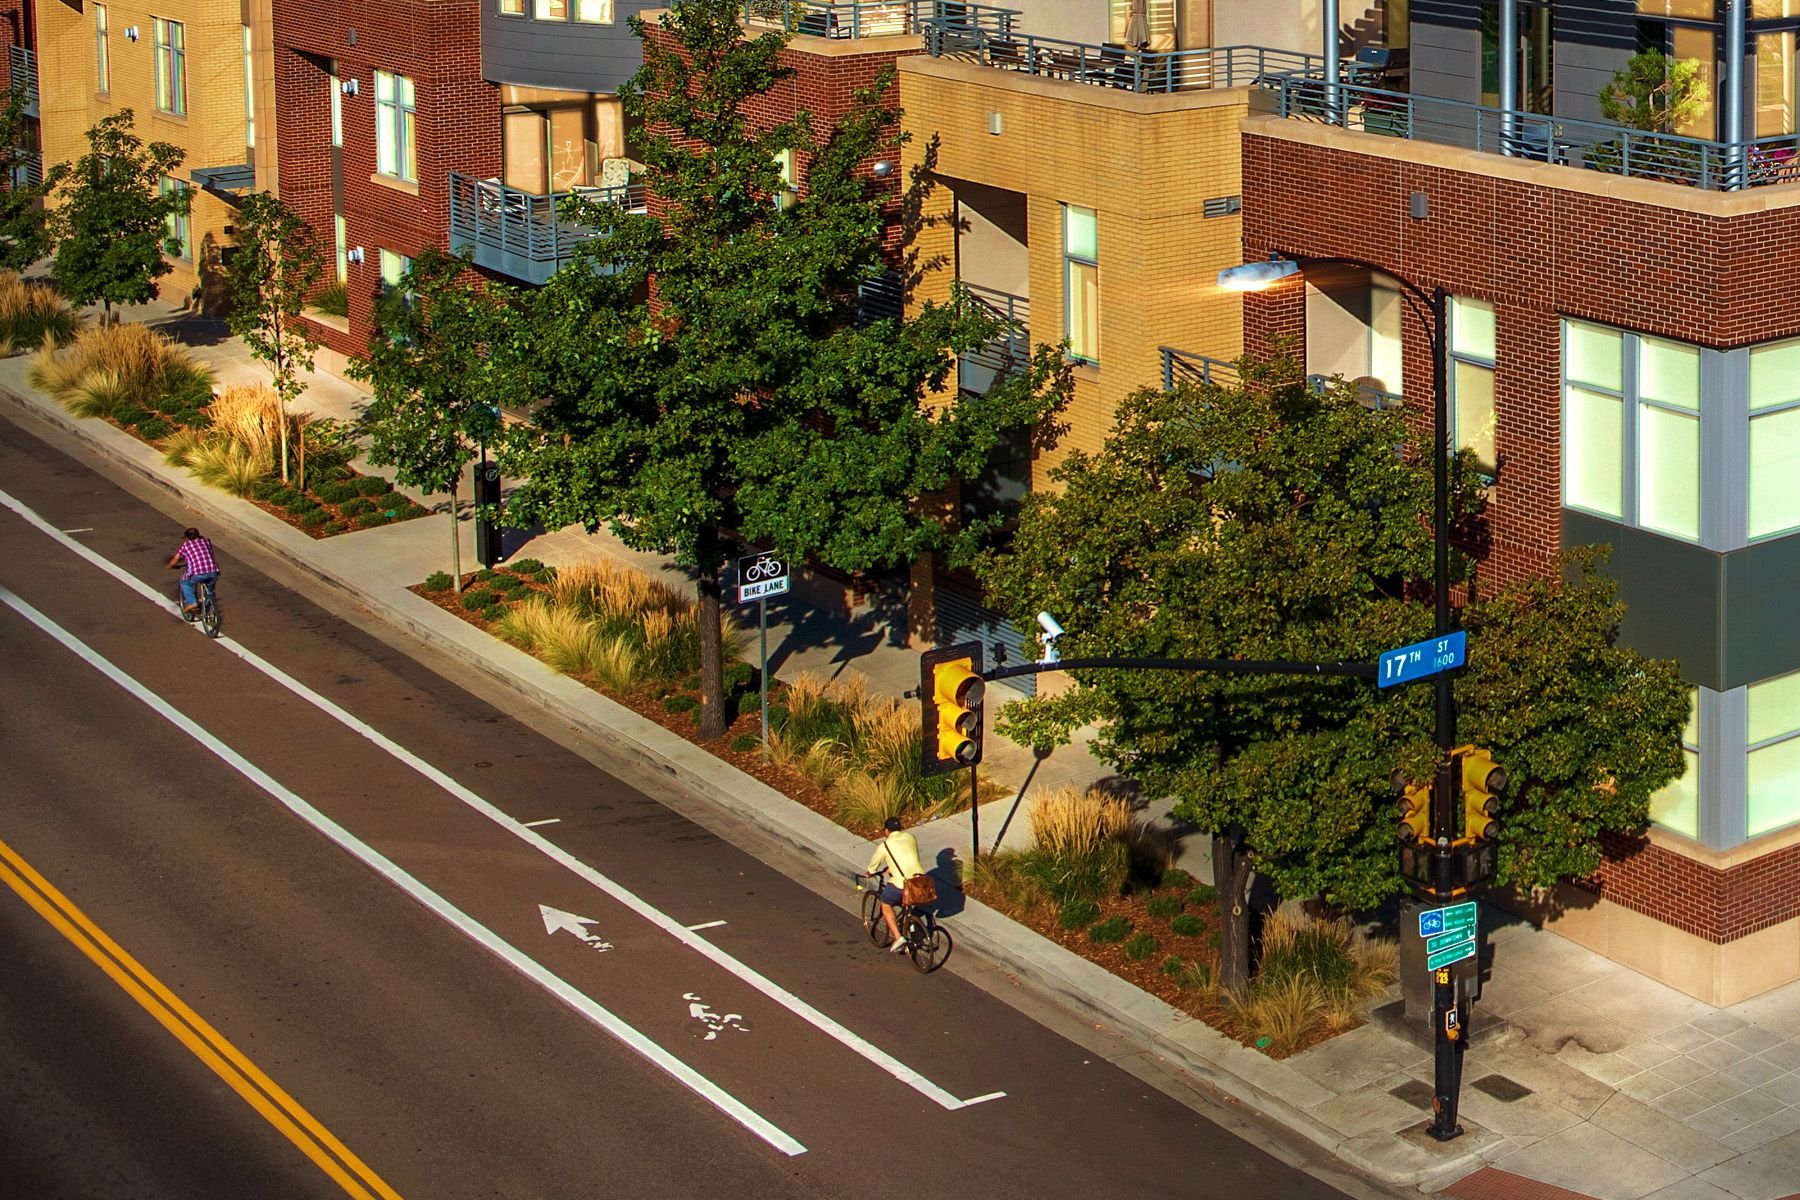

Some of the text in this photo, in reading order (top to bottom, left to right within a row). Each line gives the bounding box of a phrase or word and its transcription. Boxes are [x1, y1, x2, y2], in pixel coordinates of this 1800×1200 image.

[744, 580, 783, 597] BIKE LANE
[1437, 639, 1449, 653] ST
[1433, 652, 1455, 669] 1600
